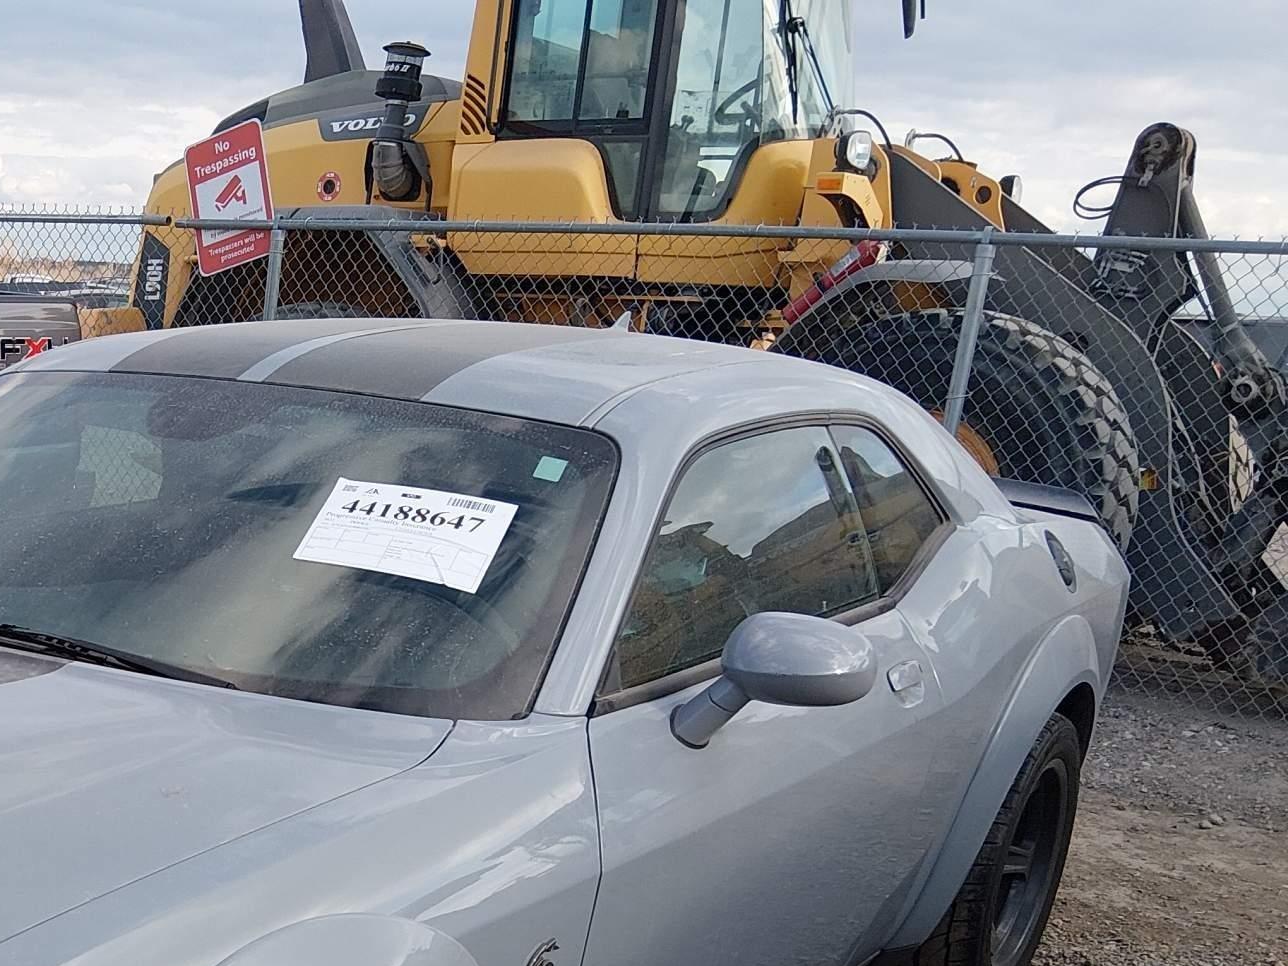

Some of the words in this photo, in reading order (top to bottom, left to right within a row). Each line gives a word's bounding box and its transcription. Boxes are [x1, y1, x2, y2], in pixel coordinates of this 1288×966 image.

[330, 114, 416, 133] VOLO
[214, 140, 230, 155] No
[194, 146, 257, 179] Trespassing
[209, 239, 244, 257] Trespassers
[244, 233, 256, 245] will
[255, 232, 265, 240] be
[220, 244, 255, 264] prosecuted
[144, 258, 164, 301] L90H
[341, 499, 486, 534] 44188647
